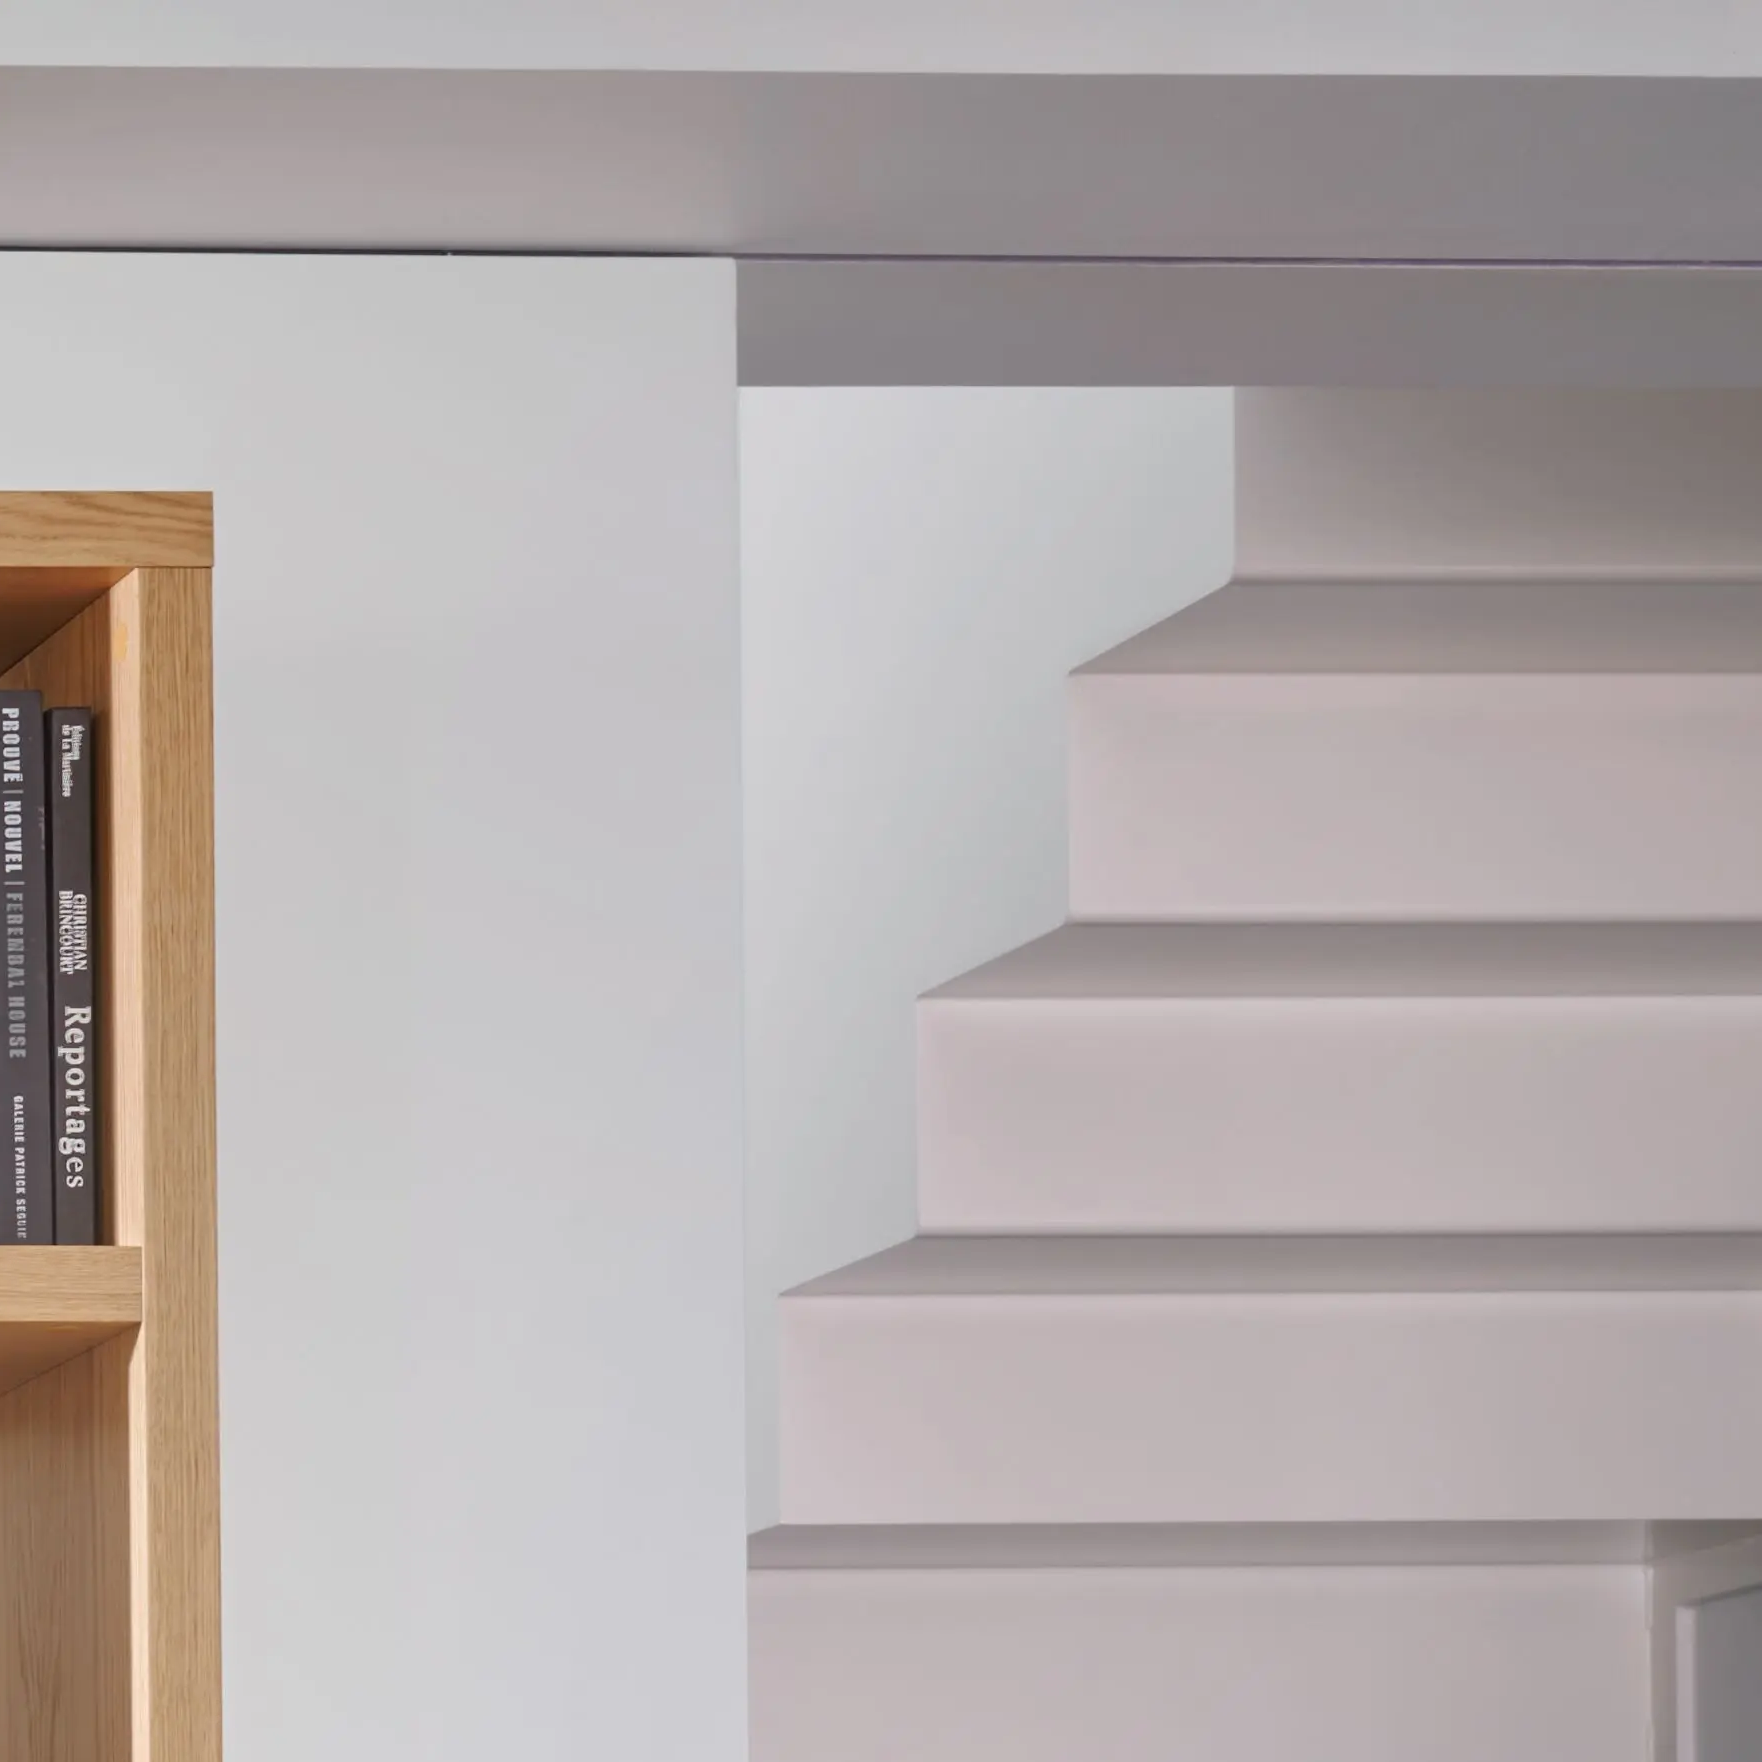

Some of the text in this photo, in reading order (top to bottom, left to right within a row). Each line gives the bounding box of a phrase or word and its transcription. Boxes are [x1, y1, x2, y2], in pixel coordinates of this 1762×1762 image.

[3, 800, 23, 873] NOUVEL
[7, 996, 27, 1059] HOUSE
[57, 1005, 92, 1188] Reportages
[13, 1095, 26, 1194] GALERIE PATRICK
